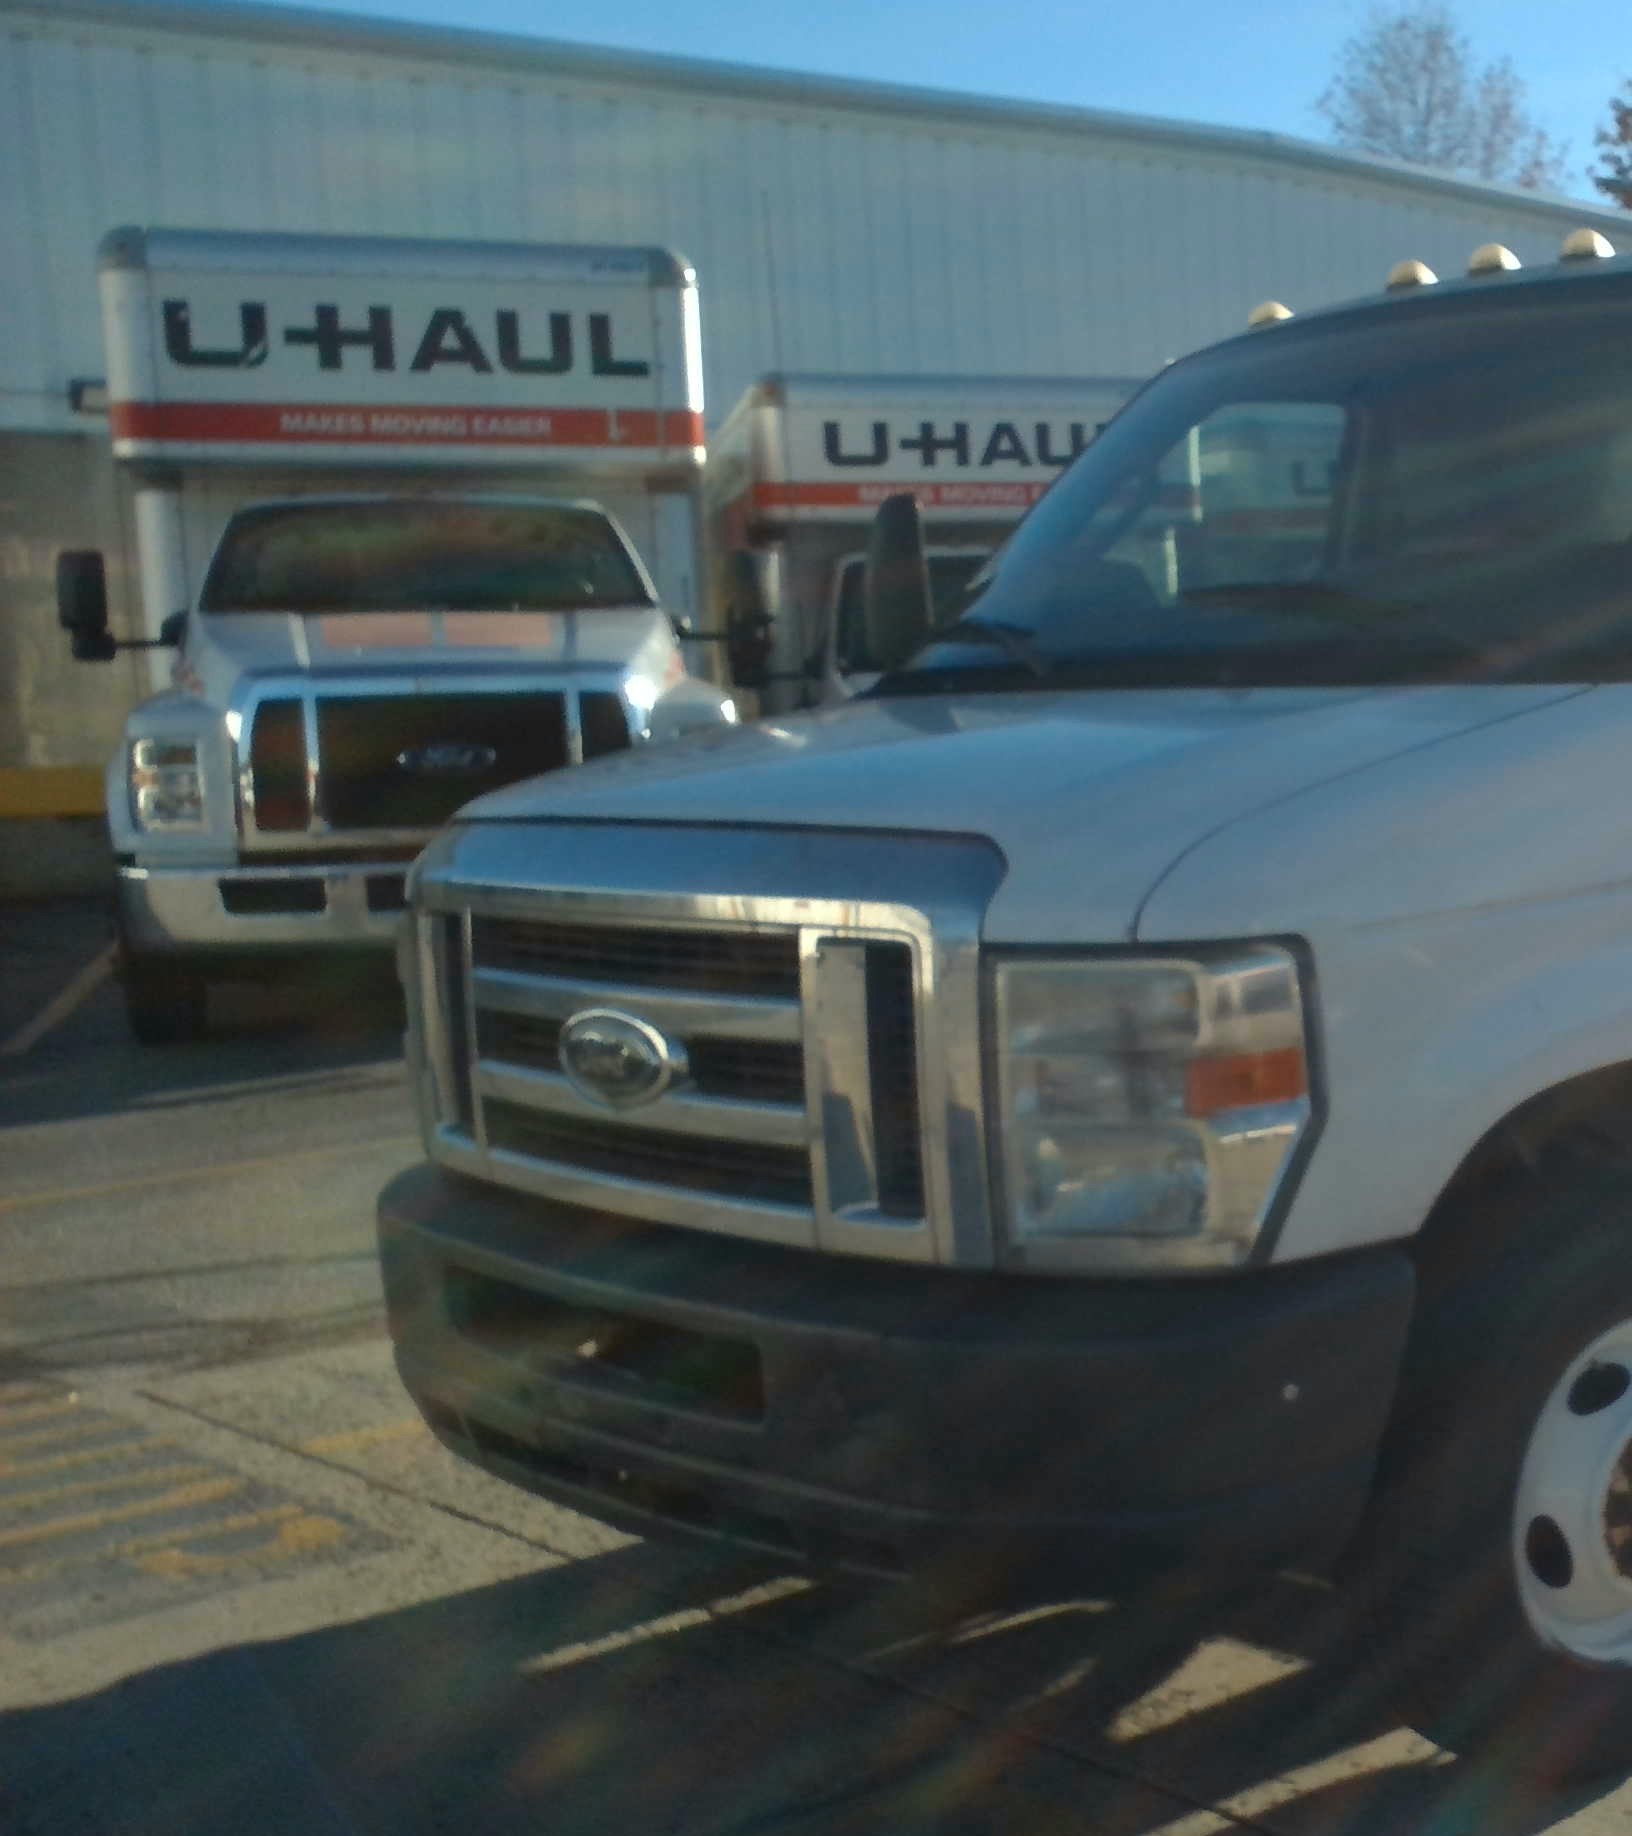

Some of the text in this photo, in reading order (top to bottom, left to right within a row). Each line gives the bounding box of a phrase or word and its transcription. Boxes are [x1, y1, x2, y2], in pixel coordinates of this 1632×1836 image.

[162, 299, 651, 376] U-HAUL
[279, 411, 364, 434] MAKES
[369, 413, 466, 436] MOVING
